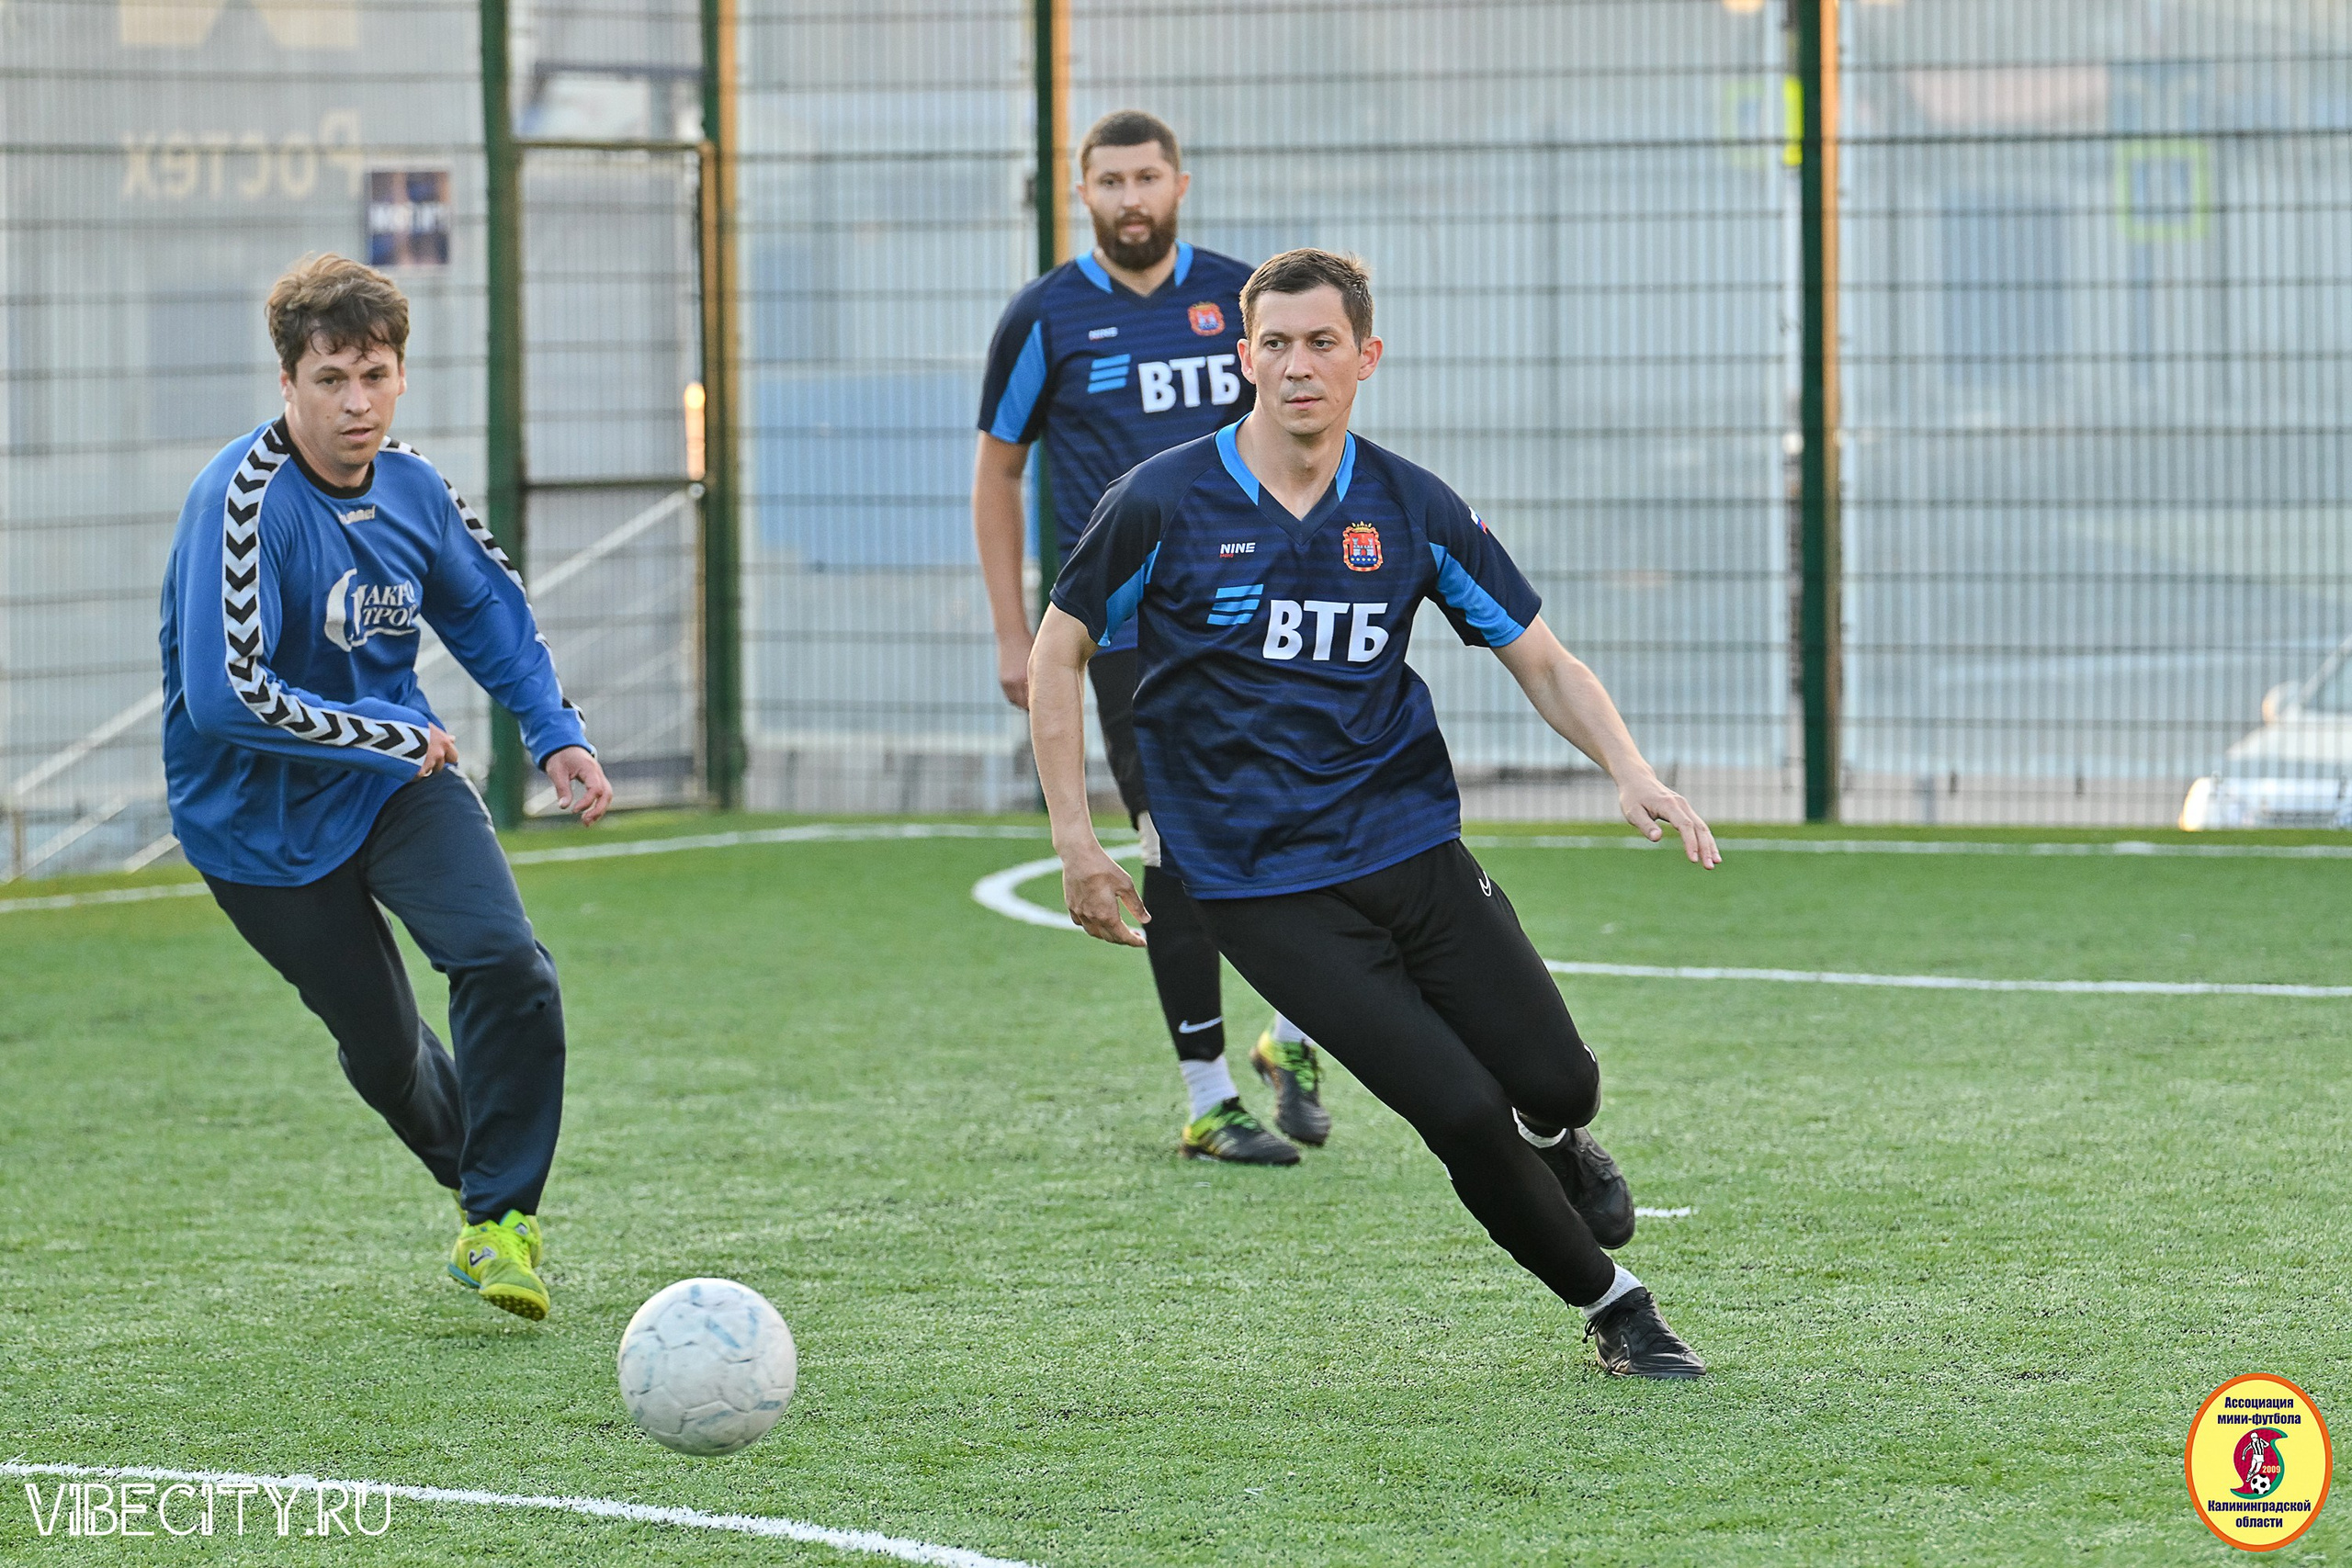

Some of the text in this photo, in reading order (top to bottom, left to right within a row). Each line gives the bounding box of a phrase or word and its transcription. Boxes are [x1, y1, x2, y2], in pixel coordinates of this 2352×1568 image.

[1137, 354, 1240, 413] ВТБ
[1220, 542, 1256, 553] NINE
[1262, 599, 1389, 662] ВТБ
